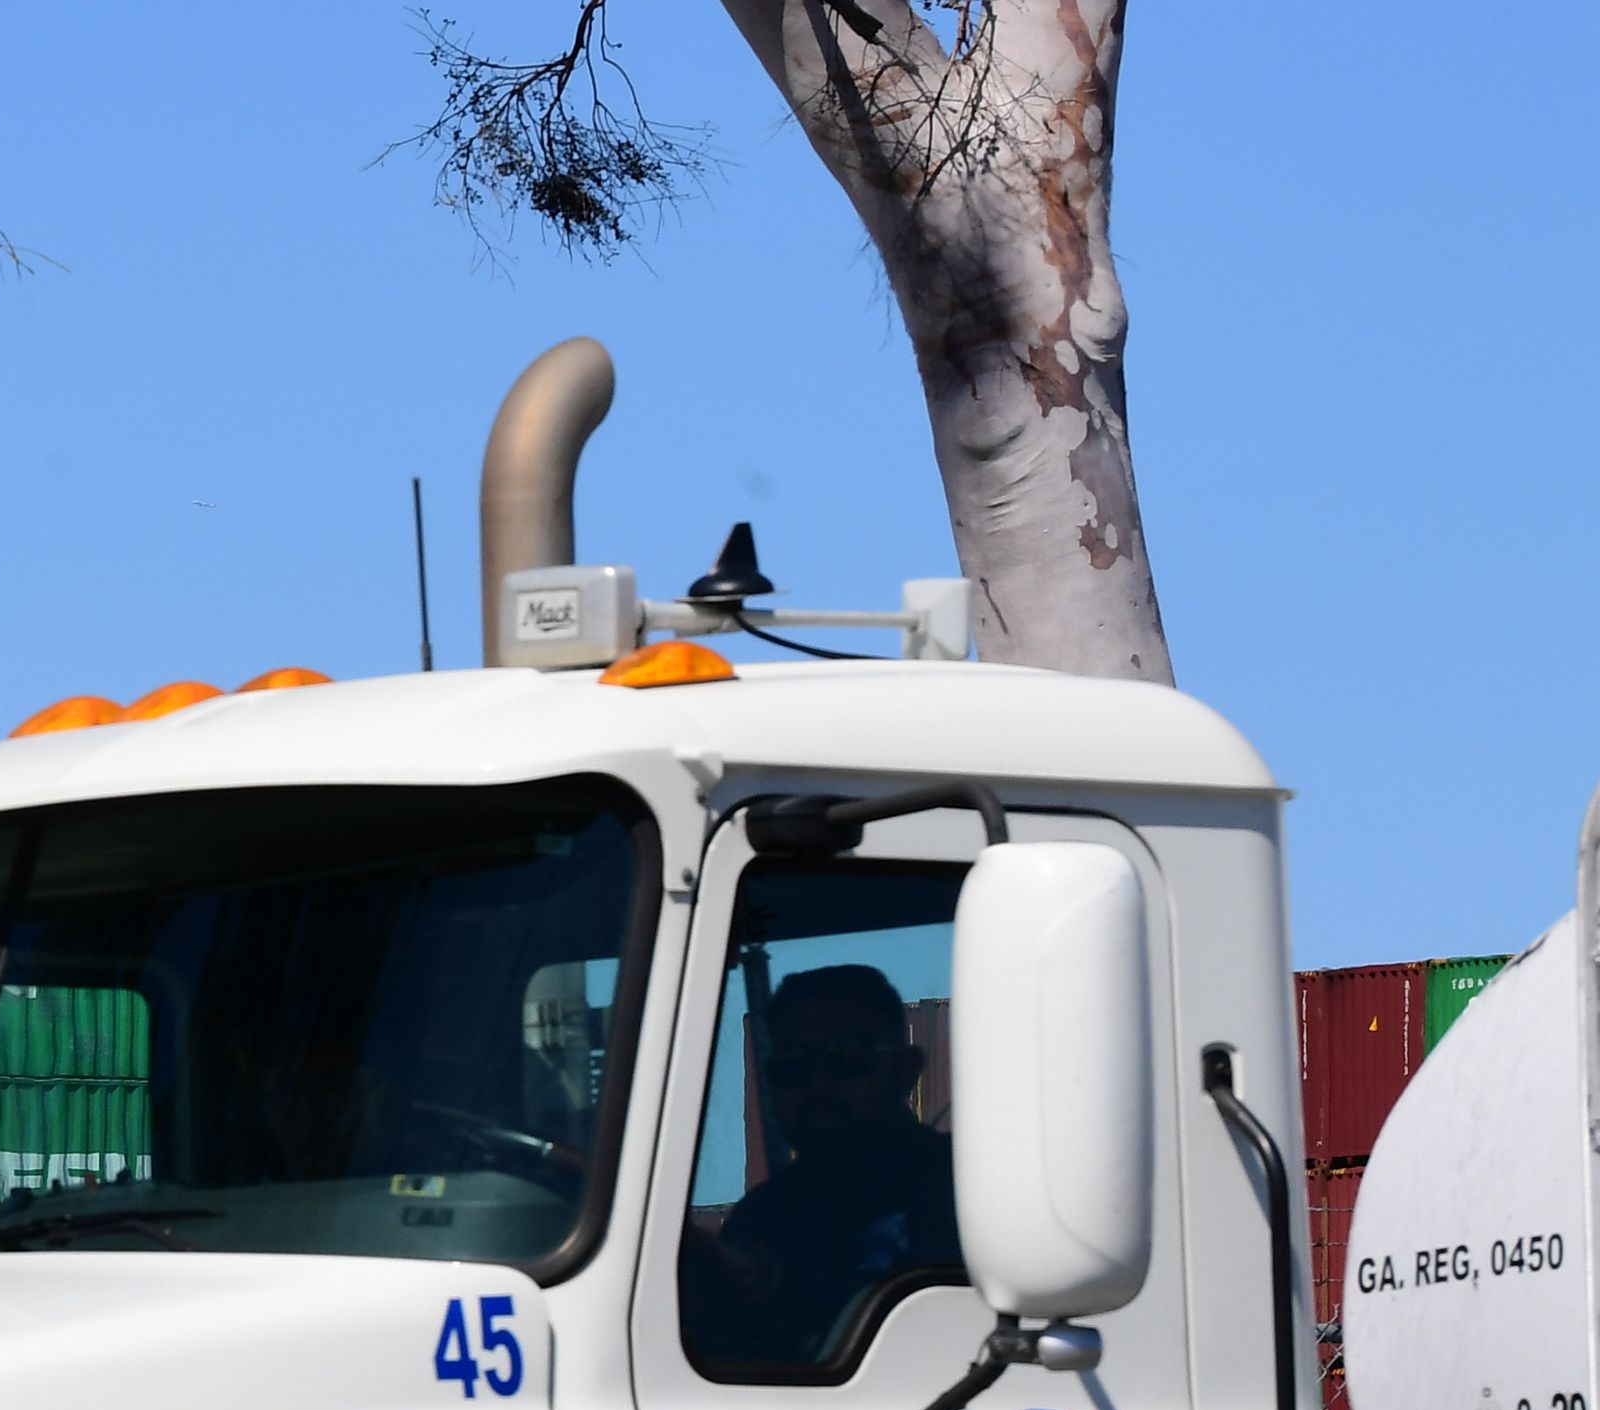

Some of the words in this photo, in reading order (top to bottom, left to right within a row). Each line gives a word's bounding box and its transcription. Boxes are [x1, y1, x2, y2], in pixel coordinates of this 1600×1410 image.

[522, 601, 576, 632] Mack
[1490, 1233, 1564, 1277] 0450
[433, 1294, 524, 1400] 45
